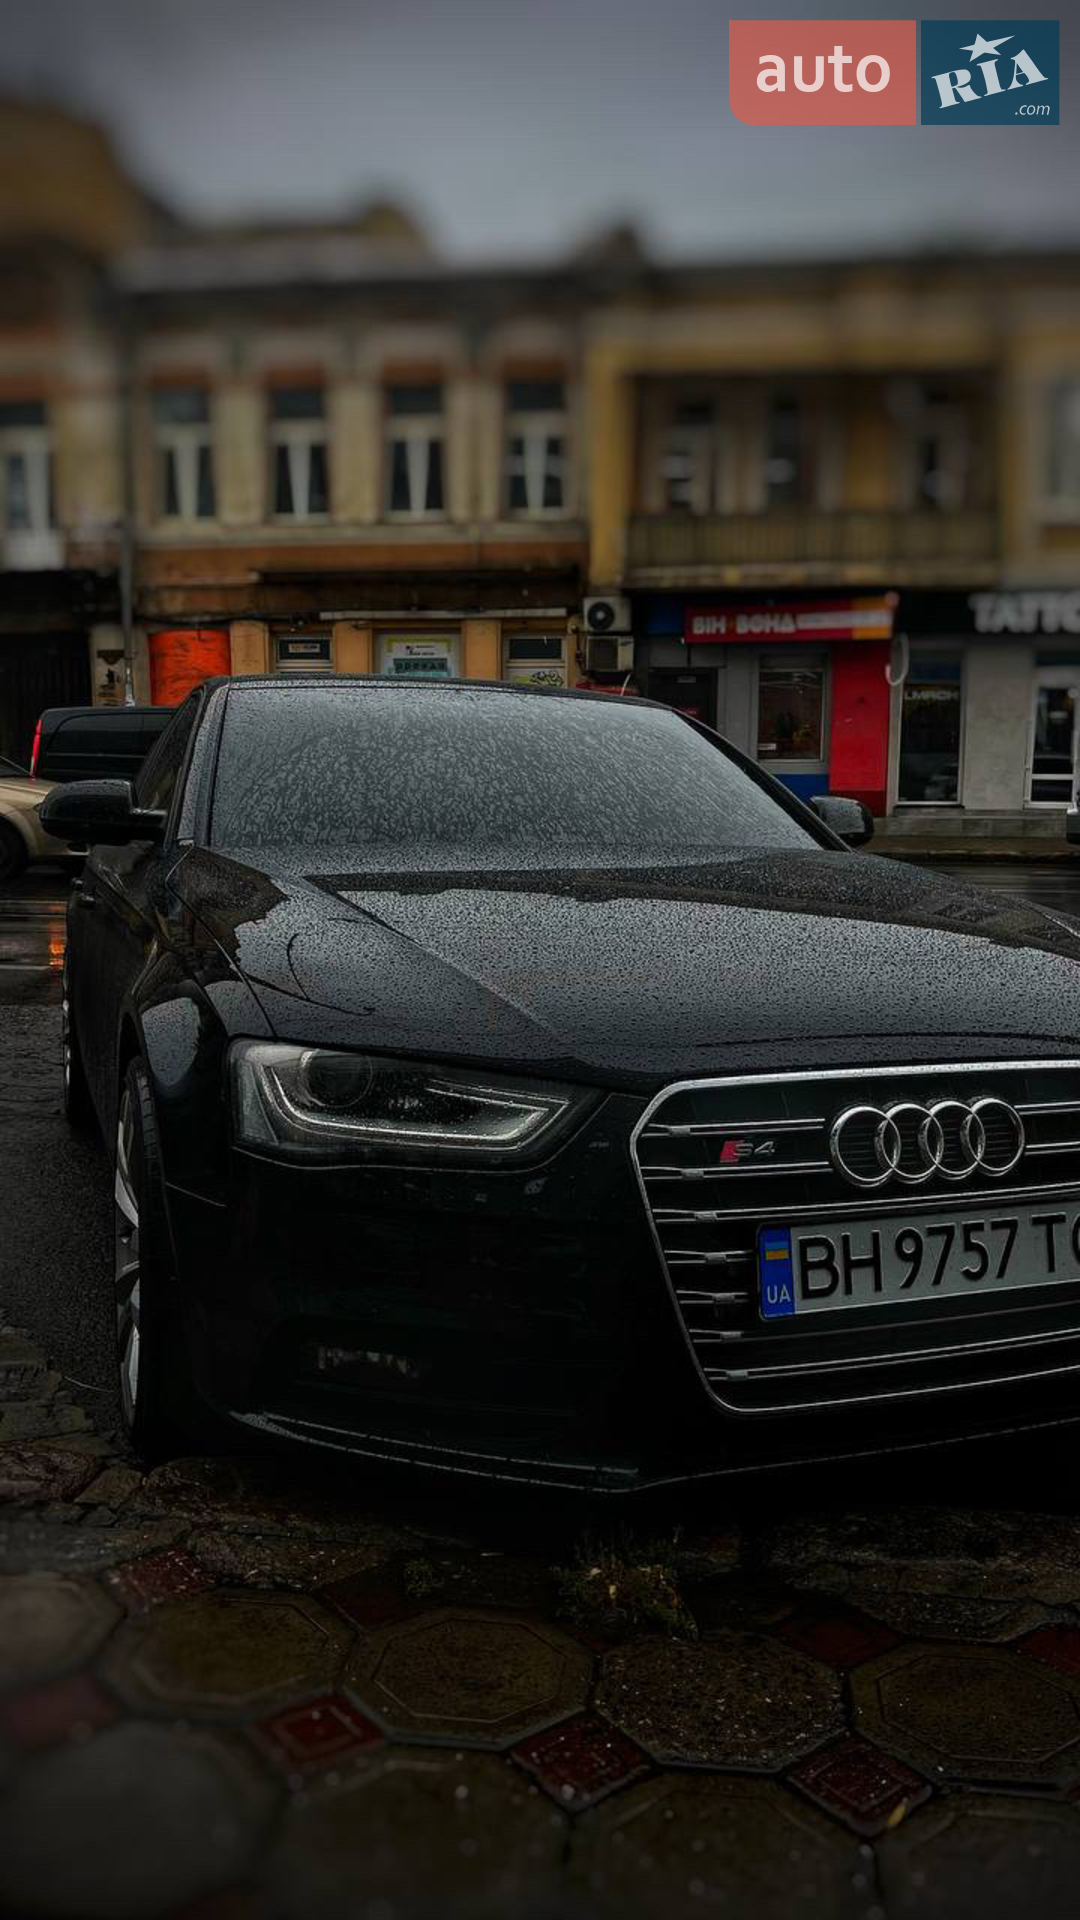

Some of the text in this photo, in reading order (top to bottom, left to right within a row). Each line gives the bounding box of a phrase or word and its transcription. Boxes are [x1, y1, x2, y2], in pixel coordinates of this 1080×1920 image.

[733, 1140, 777, 1158] S4
[798, 1230, 883, 1300] BH
[894, 1218, 1019, 1291] 9757
[766, 1281, 792, 1305] UA
